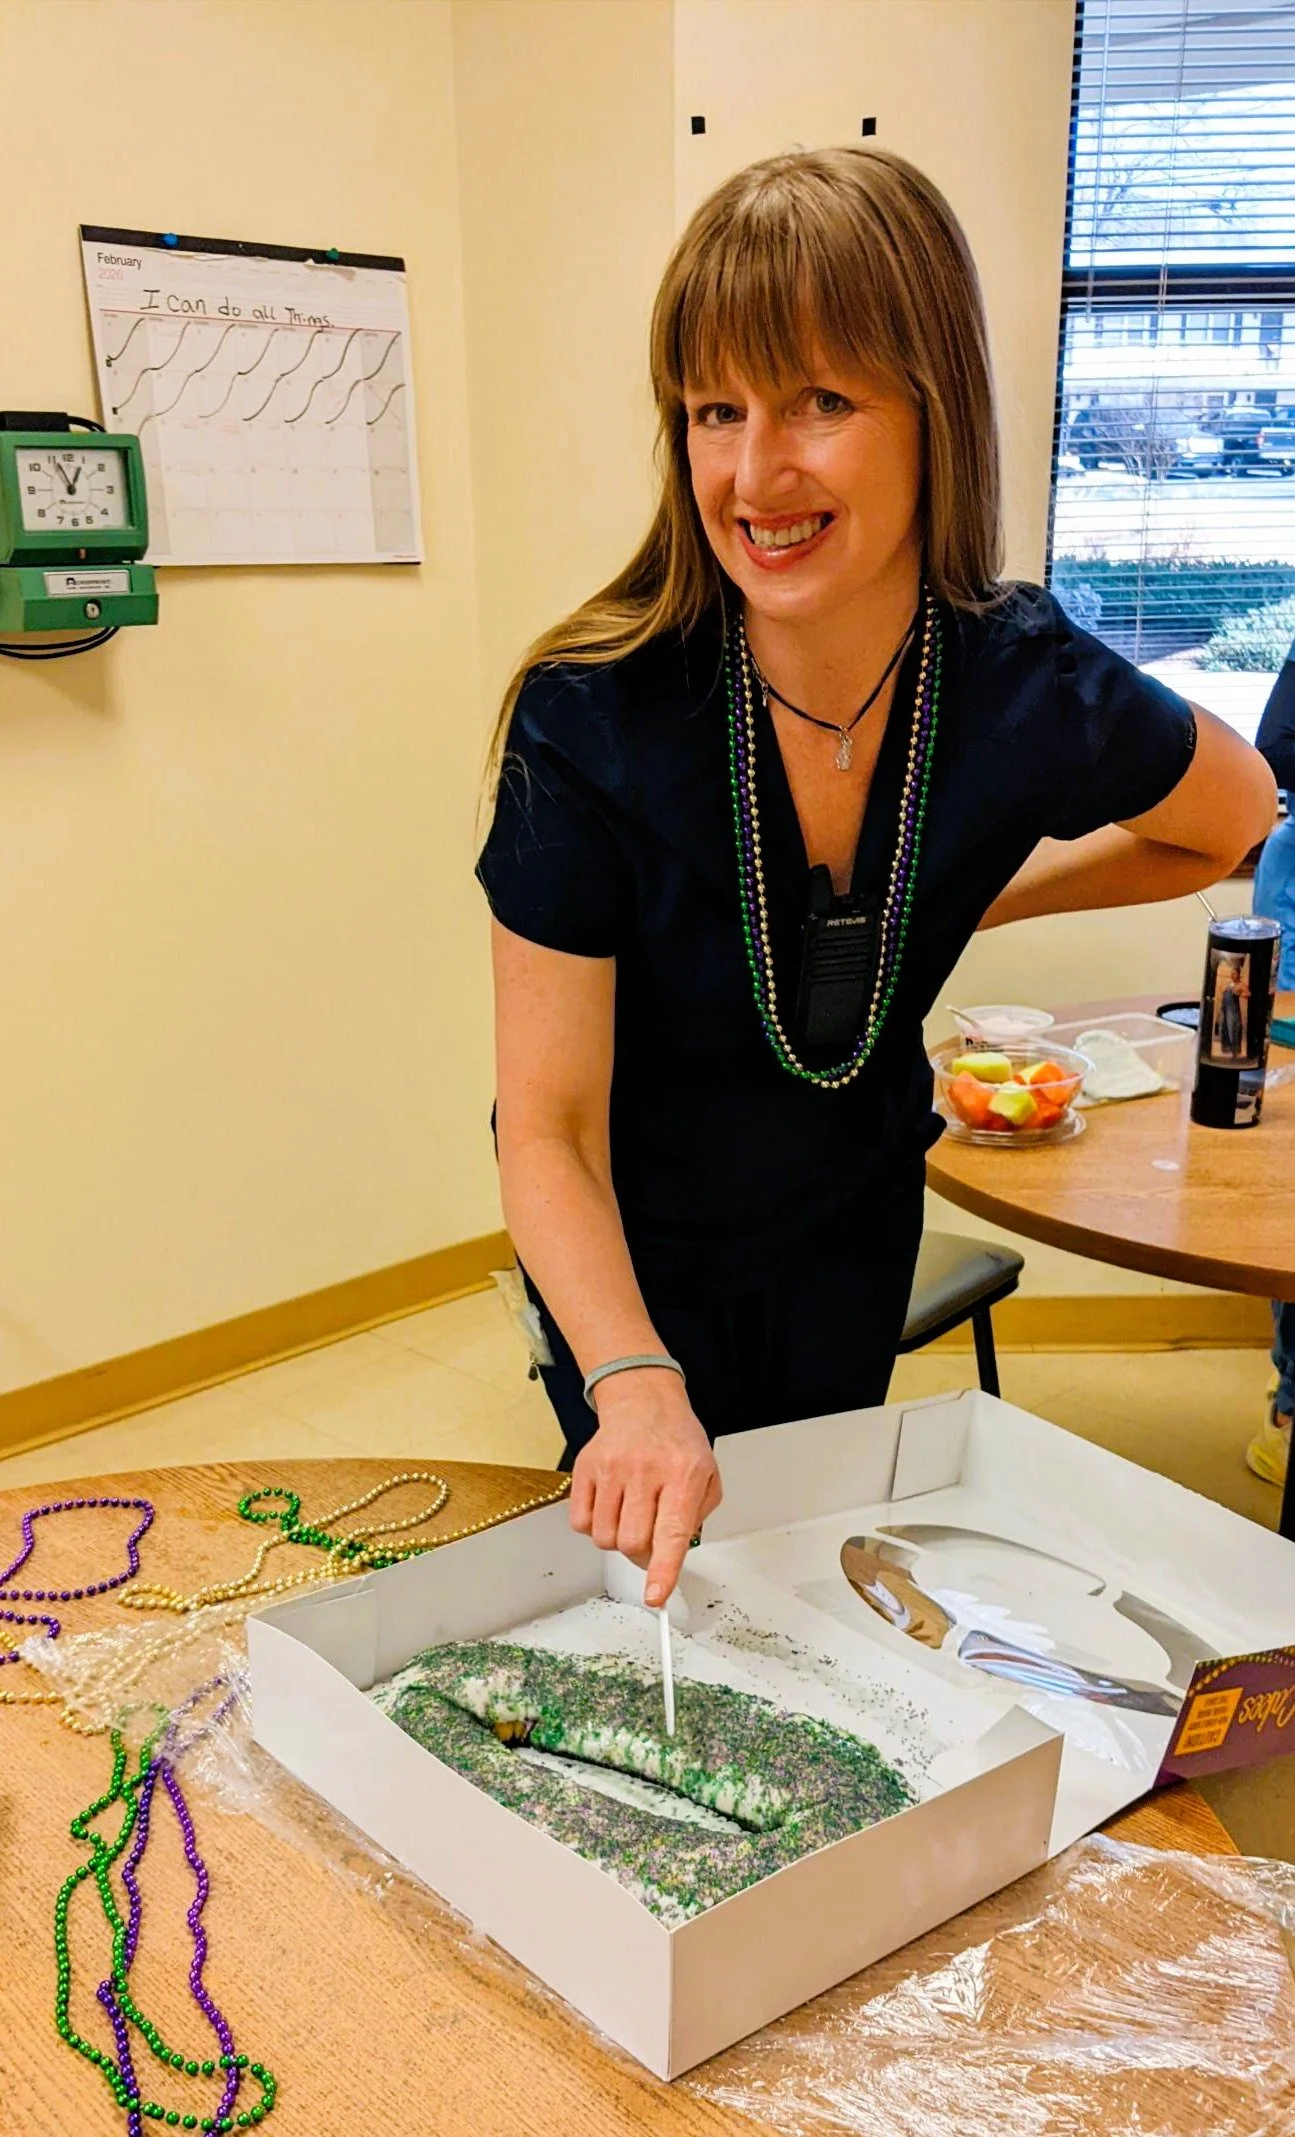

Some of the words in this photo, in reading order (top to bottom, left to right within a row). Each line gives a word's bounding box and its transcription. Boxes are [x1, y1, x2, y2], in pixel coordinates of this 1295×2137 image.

[97, 252, 142, 269] February
[140, 289, 160, 310] I
[218, 296, 241, 317] do
[252, 305, 276, 321] all
[62, 453, 75, 463] 12
[29, 463, 42, 472] 10
[97, 463, 106, 472] 2
[27, 486, 36, 495] 9
[106, 486, 115, 495] 3
[37, 509, 46, 518] 8
[100, 508, 109, 517] 4
[56, 516, 65, 525] 7
[71, 518, 80, 527] 6
[85, 516, 94, 525] 5
